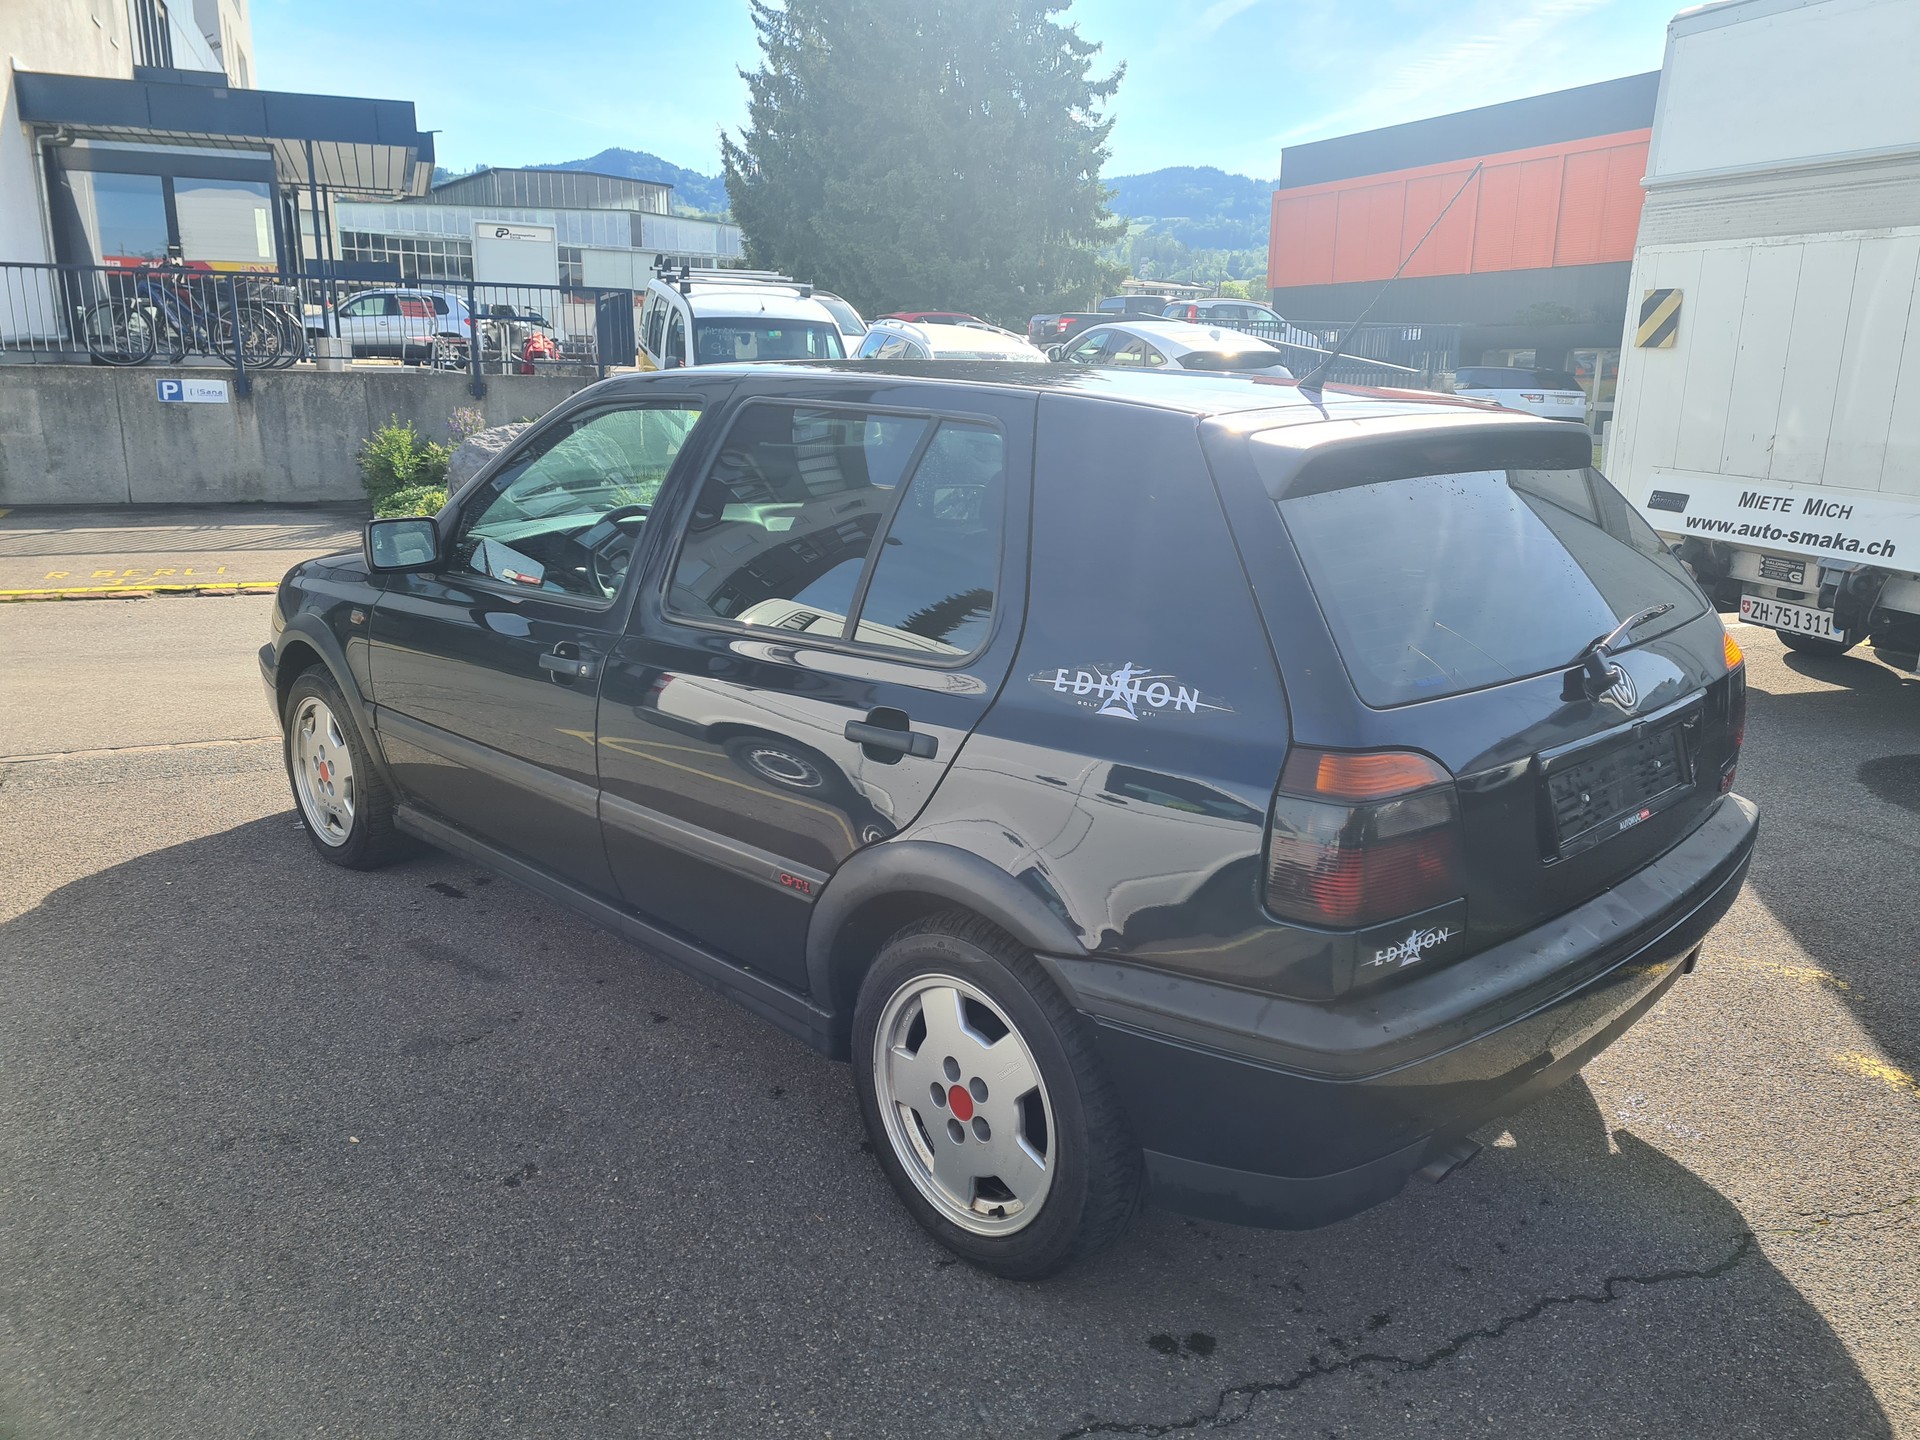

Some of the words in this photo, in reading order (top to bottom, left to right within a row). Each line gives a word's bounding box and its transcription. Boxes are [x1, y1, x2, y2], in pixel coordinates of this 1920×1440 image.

[162, 381, 178, 400] P
[1738, 491, 1794, 512] MIETE
[1803, 498, 1853, 519] MICH
[1686, 516, 1896, 558] www.auto-smaka.ch
[1077, 700, 1098, 708] GOLF
[780, 873, 811, 894] GTI
